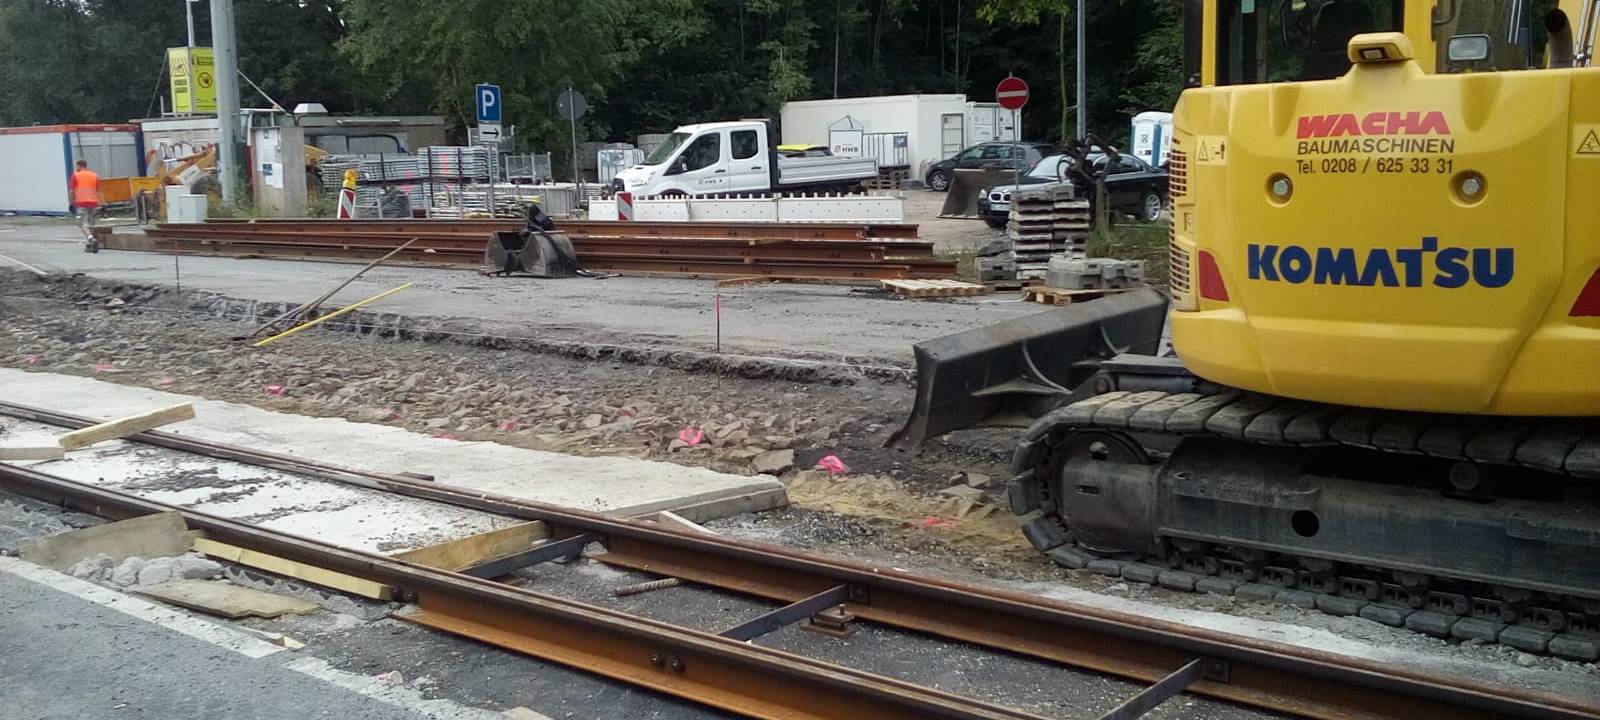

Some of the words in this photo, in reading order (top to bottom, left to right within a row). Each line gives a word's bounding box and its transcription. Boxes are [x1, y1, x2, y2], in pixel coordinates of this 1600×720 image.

[482, 89, 495, 117] P
[1296, 111, 1450, 139] WACHA
[1297, 138, 1454, 155] BAUMASCHINEN
[1296, 159, 1316, 174] Tel.
[1321, 157, 1356, 173] 0208
[1363, 157, 1370, 173] /
[1376, 157, 1403, 173] 625
[1410, 158, 1429, 173] 33
[1436, 158, 1453, 174] 31
[1247, 236, 1514, 289] KOMATSU
